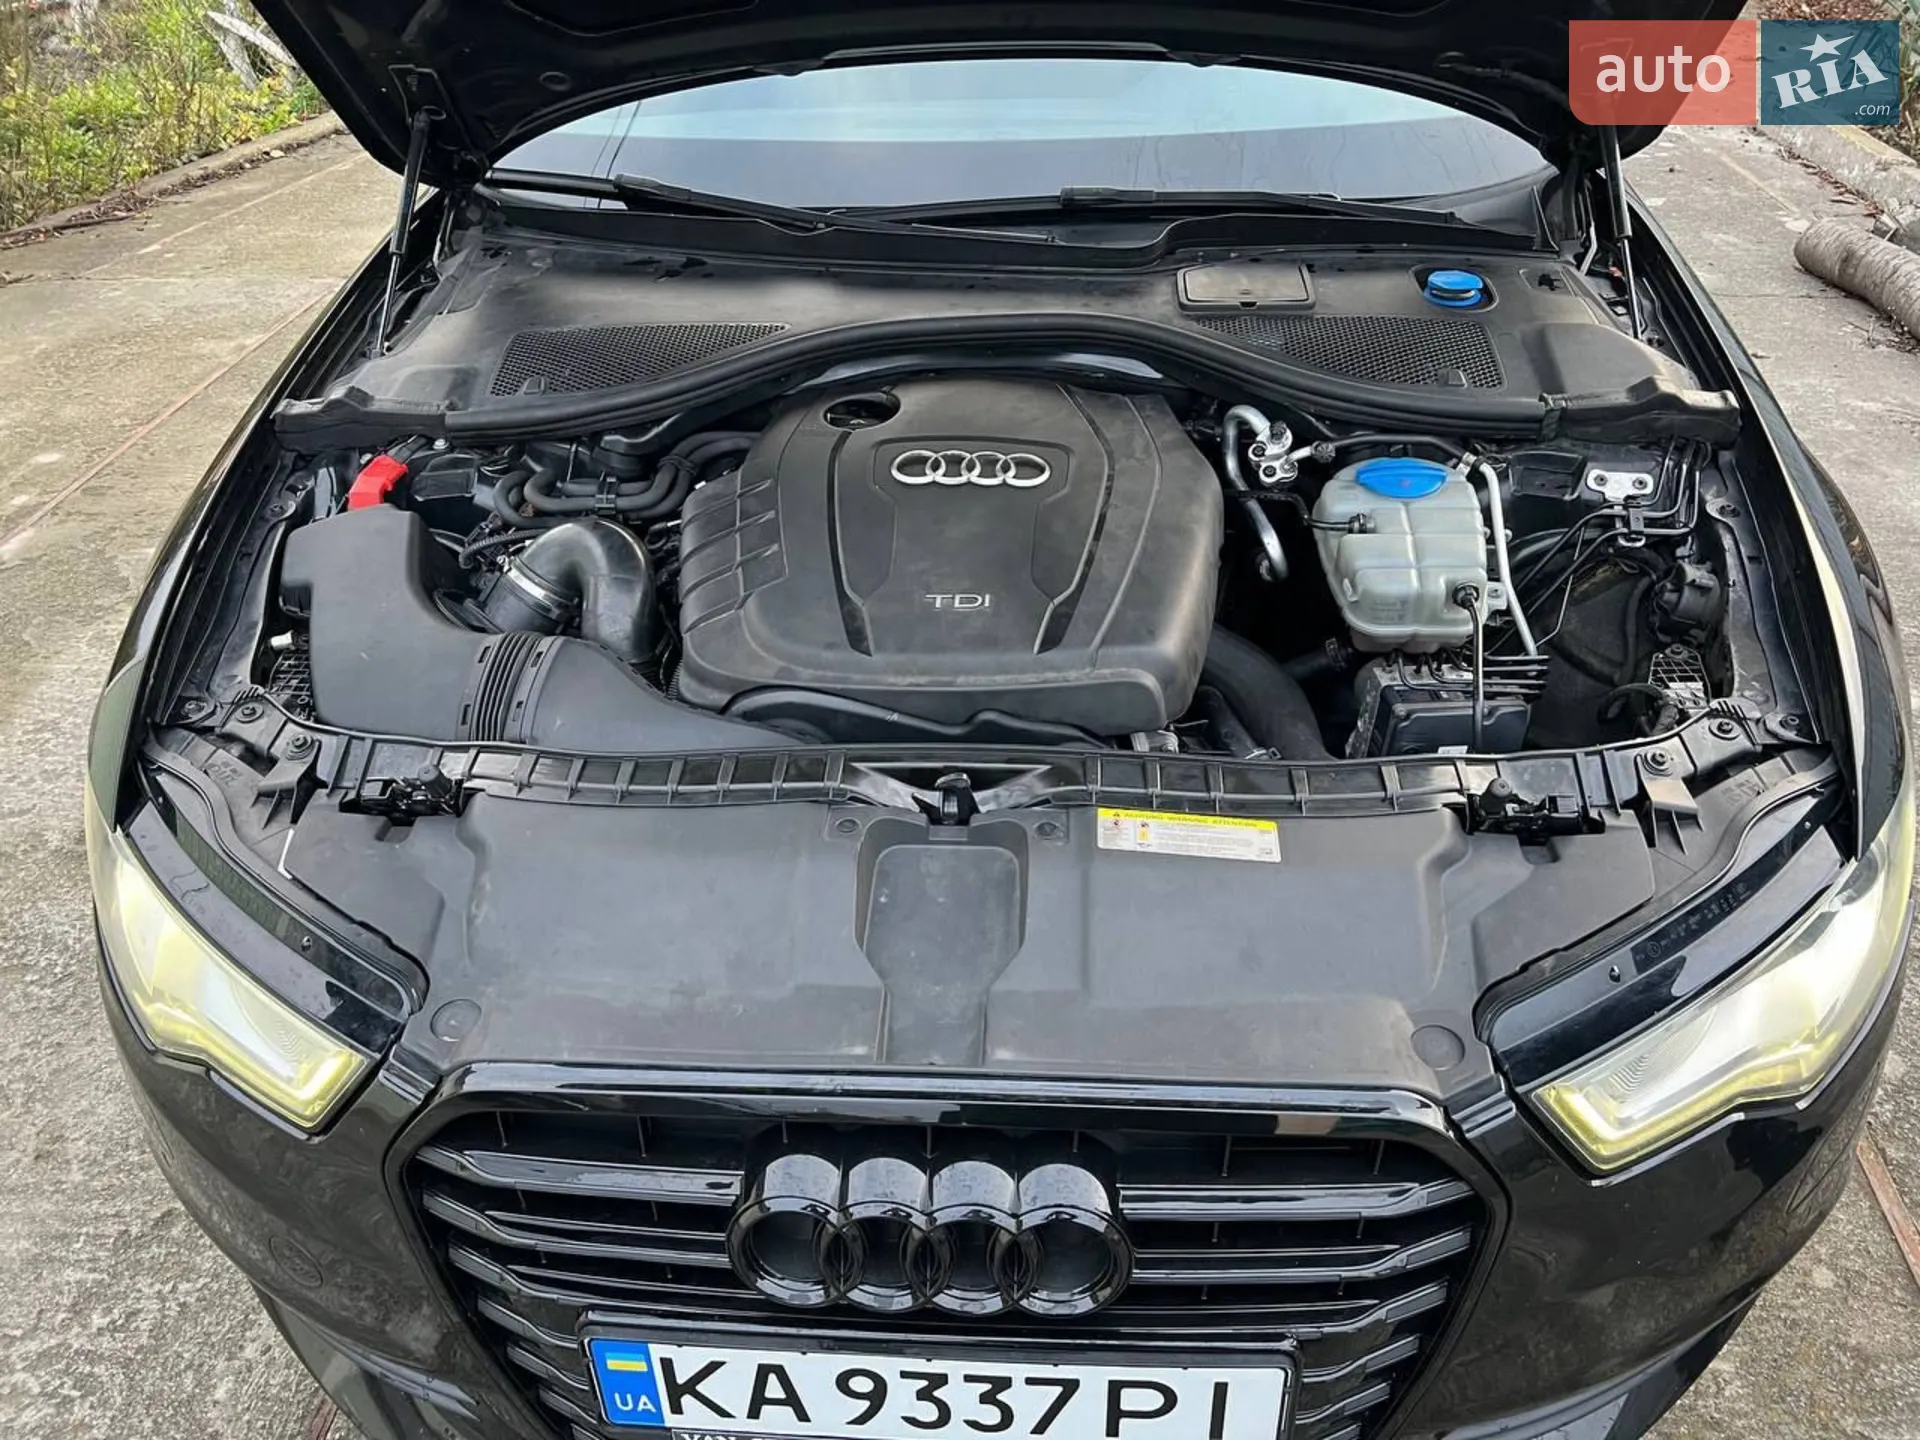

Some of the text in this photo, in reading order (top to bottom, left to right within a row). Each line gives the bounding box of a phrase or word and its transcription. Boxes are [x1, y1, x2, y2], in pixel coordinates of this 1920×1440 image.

[924, 593, 991, 608] TDI
[614, 1392, 656, 1413] UA
[659, 1356, 812, 1423] KA
[835, 1367, 1081, 1435] 9337
